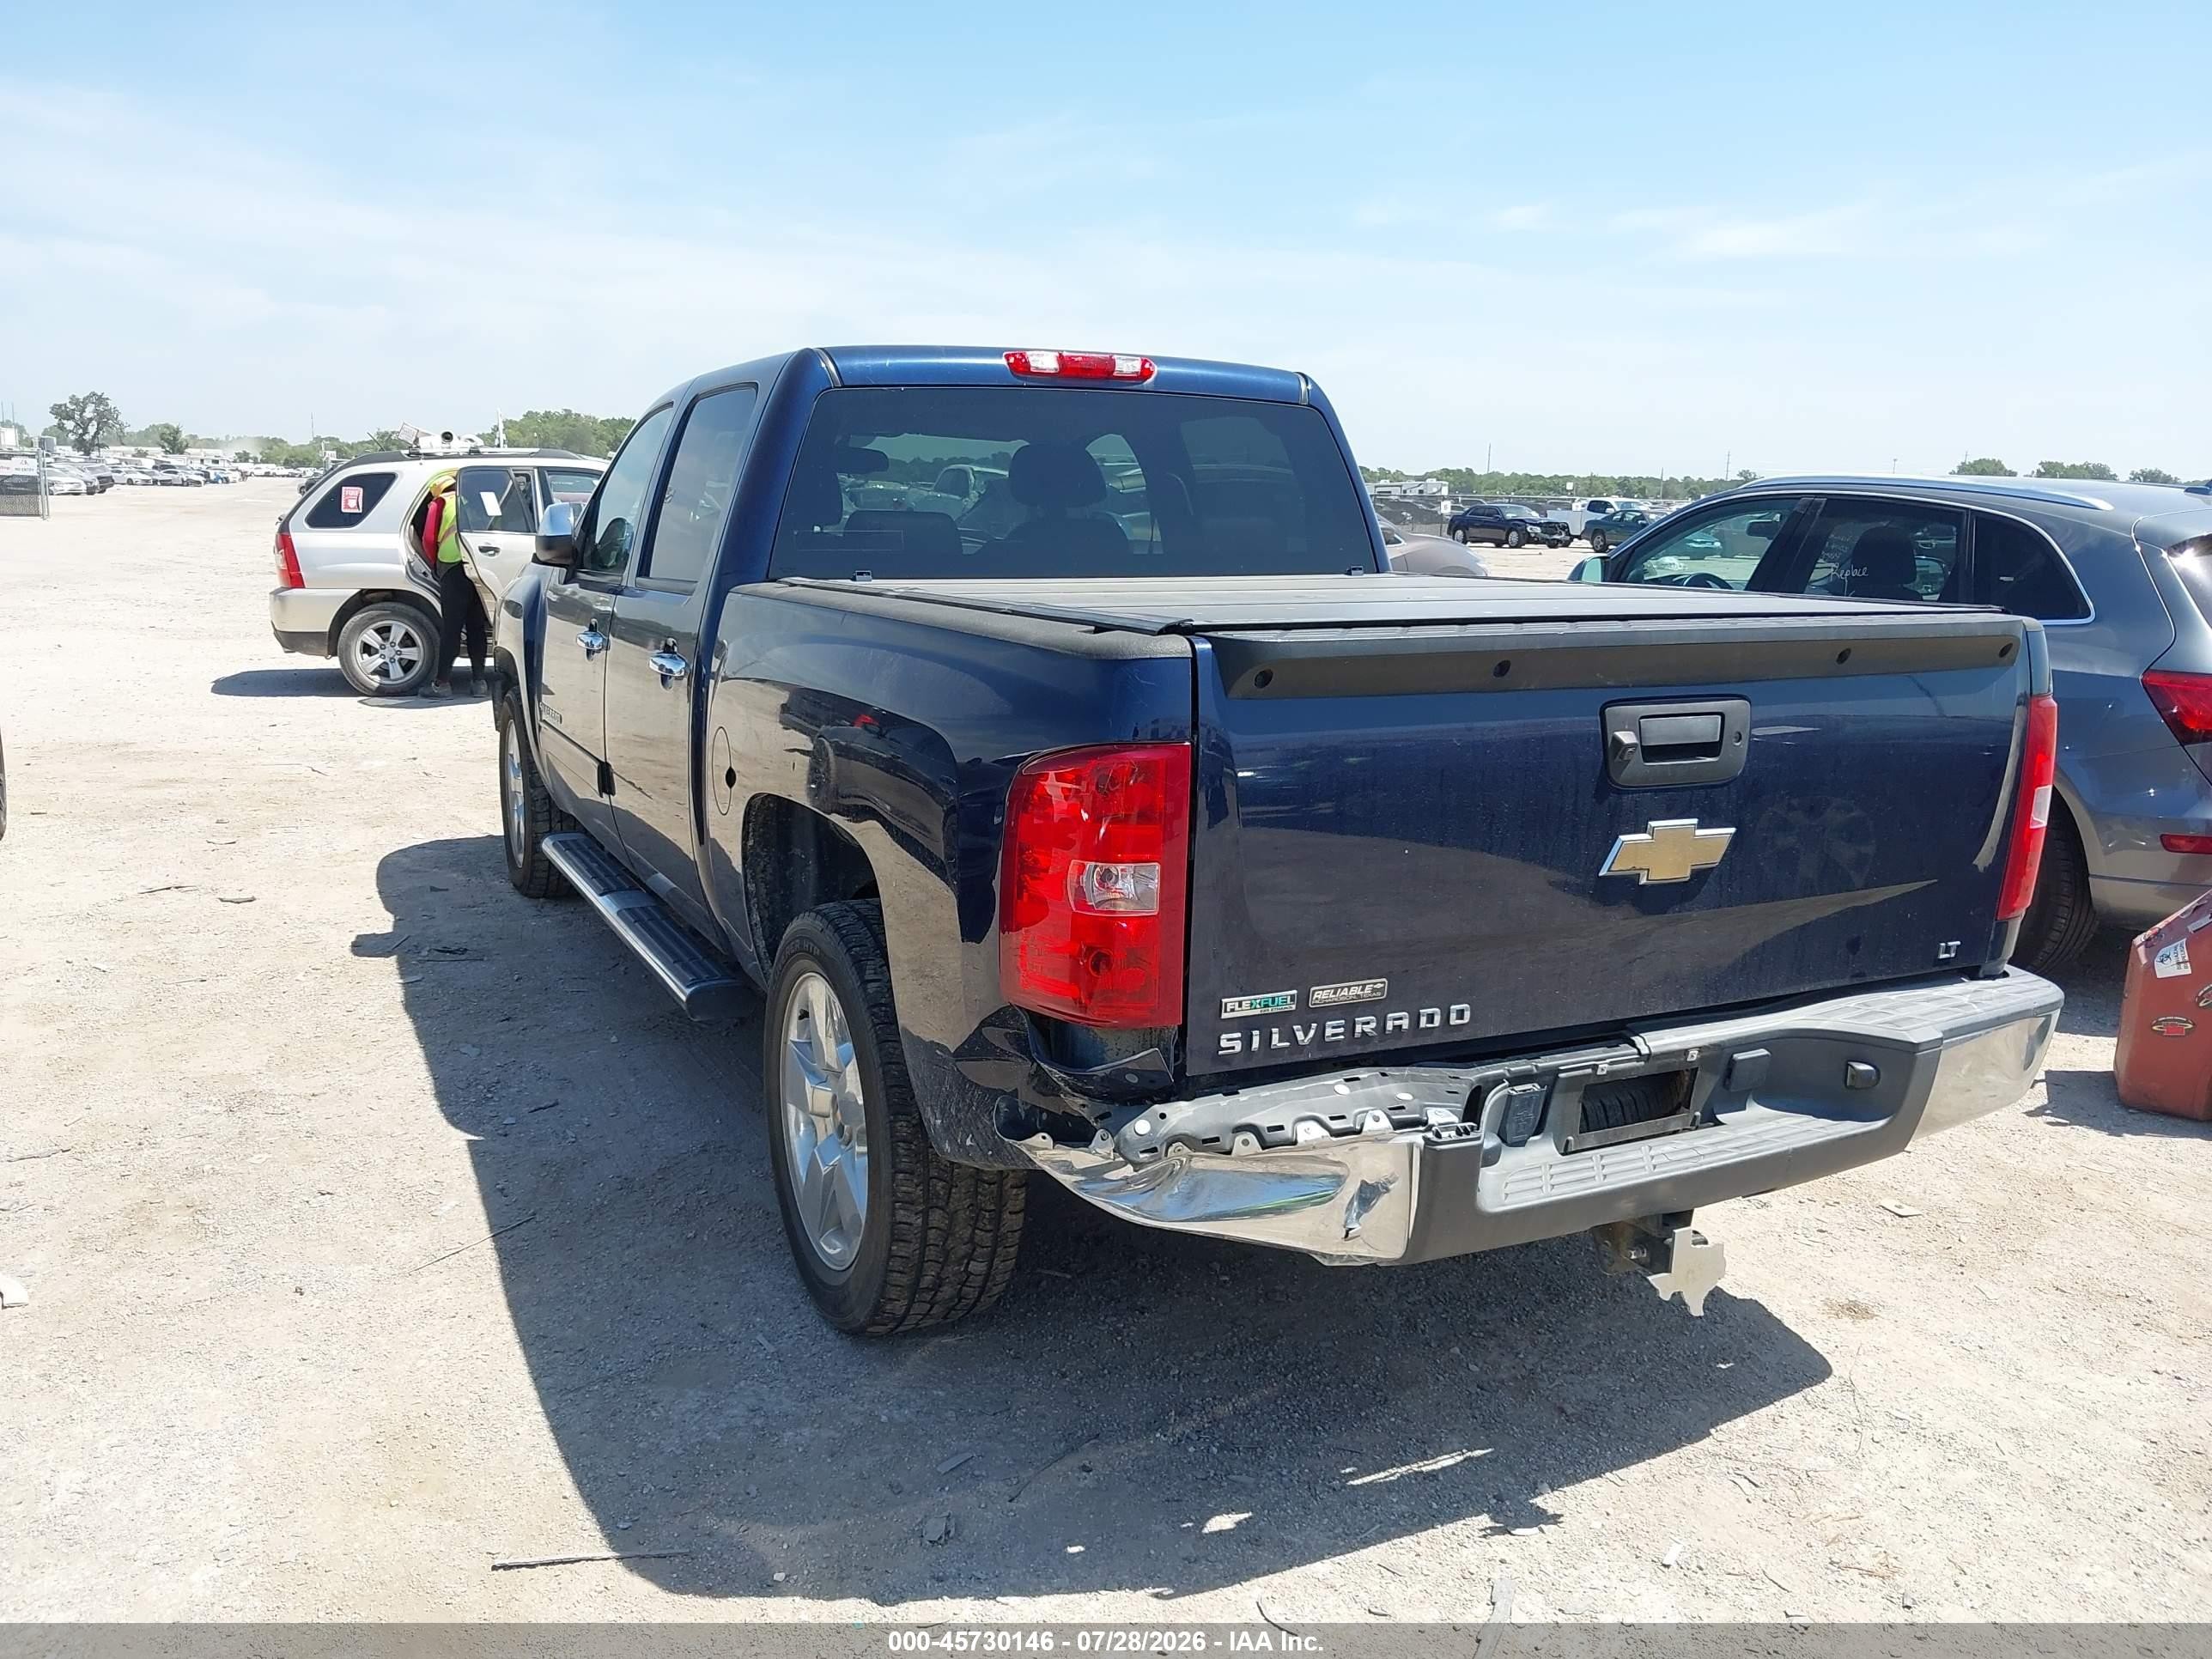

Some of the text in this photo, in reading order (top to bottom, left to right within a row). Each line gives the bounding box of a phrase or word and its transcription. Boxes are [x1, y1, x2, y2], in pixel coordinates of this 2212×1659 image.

[1830, 562, 1869, 583] Replace
[1937, 940, 1961, 958] LT
[1313, 984, 1374, 1000] RELIABLE
[1226, 995, 1294, 1012] FLEXFUEL
[1218, 1003, 1471, 1055] SILVERADO
